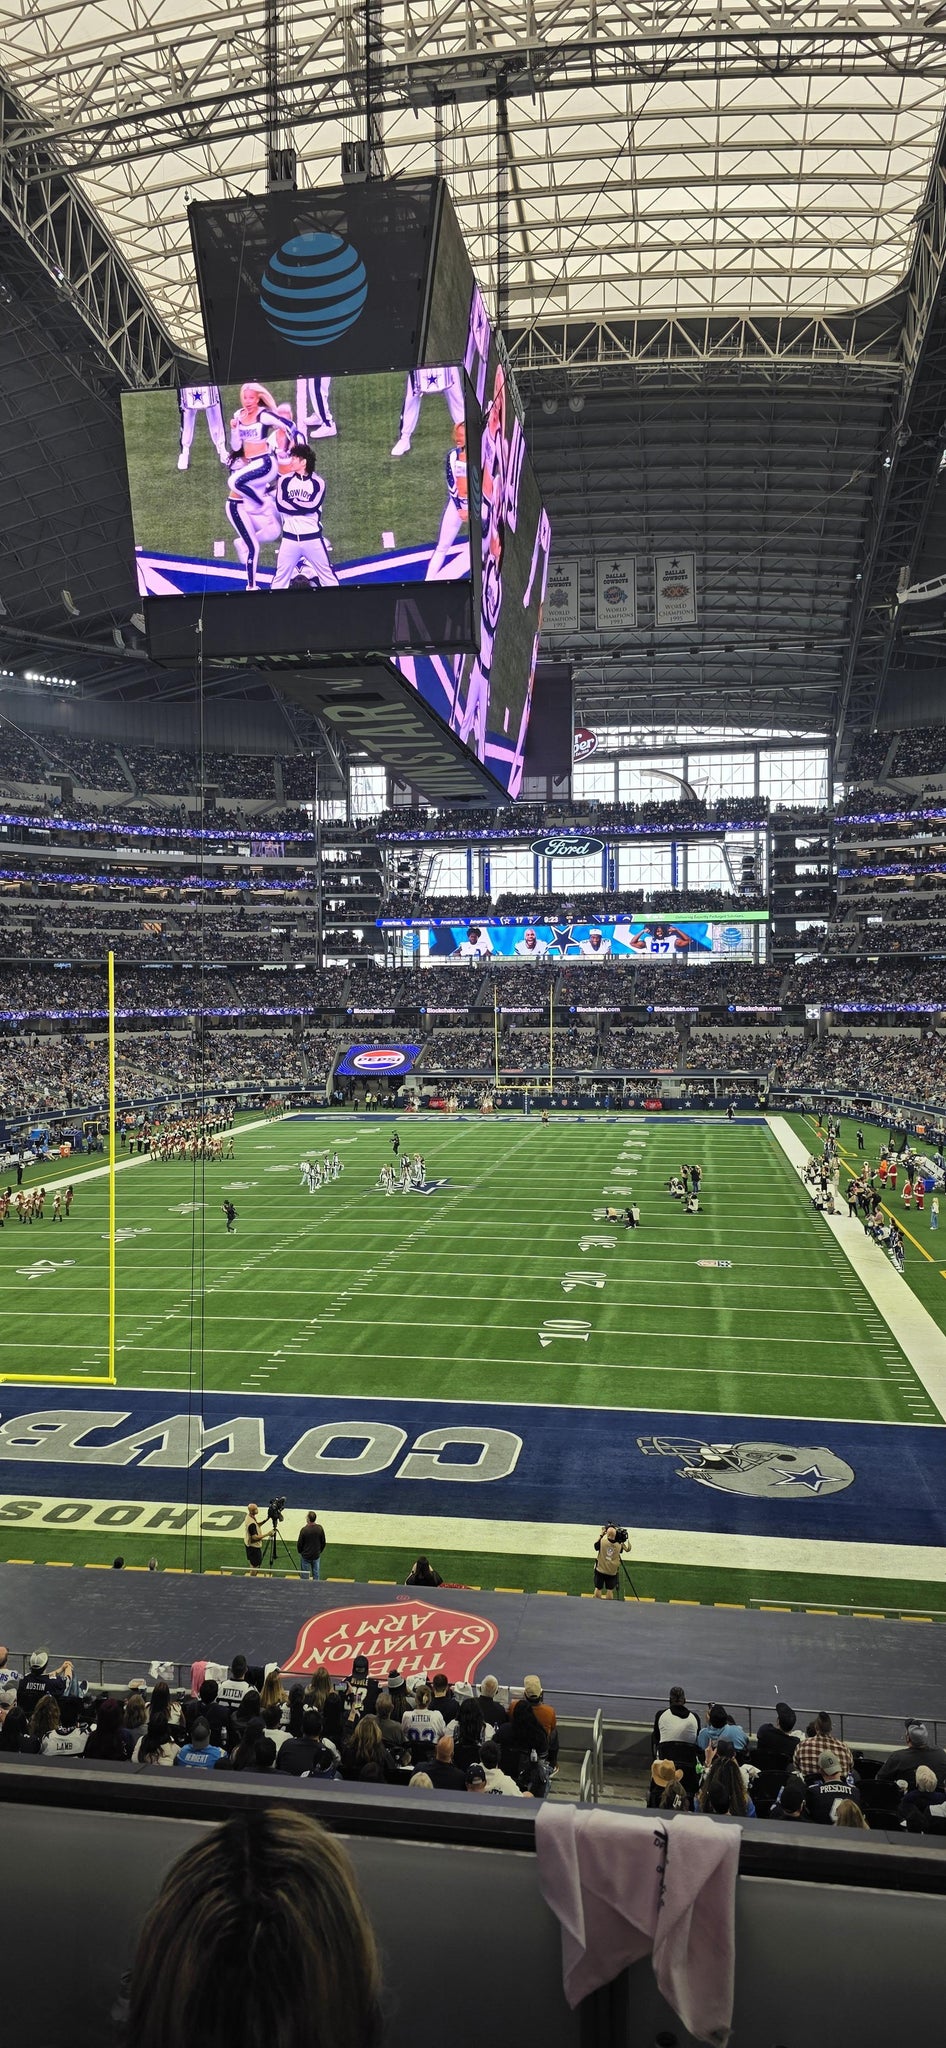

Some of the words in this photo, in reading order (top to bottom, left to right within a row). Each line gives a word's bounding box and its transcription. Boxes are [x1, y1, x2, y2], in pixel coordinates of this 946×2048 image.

[322, 702, 489, 793] WINSTAR
[544, 839, 590, 855] Ford
[515, 916, 523, 924] 17
[577, 1235, 618, 1248] 30
[16, 1259, 76, 1275] 20
[560, 1271, 608, 1289] 20
[538, 1319, 592, 1342] 10
[323, 1611, 437, 1643] ARMY
[302, 1625, 486, 1669] SALVATION
[368, 1652, 448, 1676] THE
[26, 1682, 46, 1691] AUSTIN
[222, 1687, 243, 1698] WITTEN
[411, 1714, 431, 1723] WITTEN
[56, 1742, 73, 1751] LAMB
[185, 1753, 209, 1764] HERBERT
[820, 1784, 853, 1795] PRESCOTT
